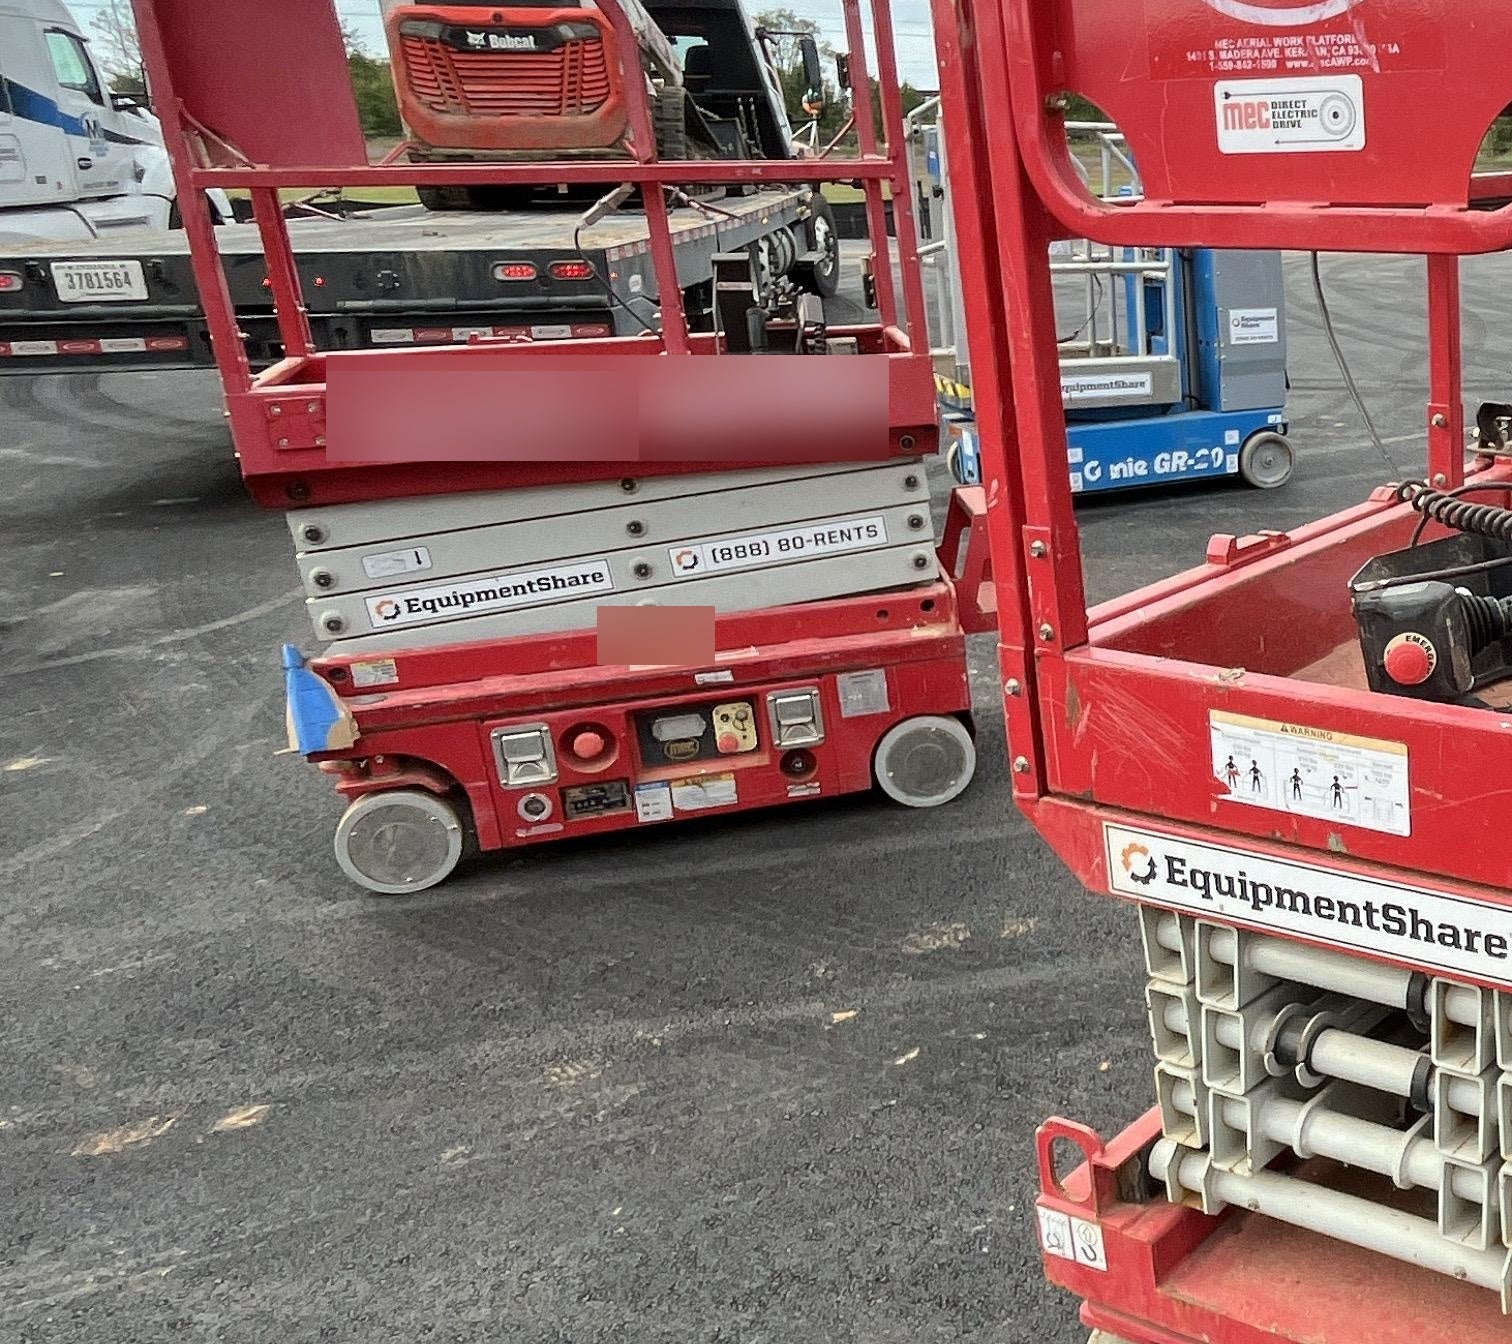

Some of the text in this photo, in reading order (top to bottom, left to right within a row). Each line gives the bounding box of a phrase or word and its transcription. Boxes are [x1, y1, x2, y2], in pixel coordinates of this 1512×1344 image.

[488, 34, 536, 49] Bobcat
[1272, 36, 1304, 47] WORK
[1271, 99, 1308, 110] DIRECT
[1271, 109, 1319, 120] ELECTRIC
[1272, 119, 1303, 129] DRIVE
[65, 271, 132, 290] 3781564
[1062, 380, 1147, 394] quipmentShare
[711, 522, 880, 565] (888) 80-RENTS
[403, 568, 605, 615] EquipmentShare
[1289, 724, 1334, 742] WARNING
[1163, 854, 1509, 961] EquipmentShare
